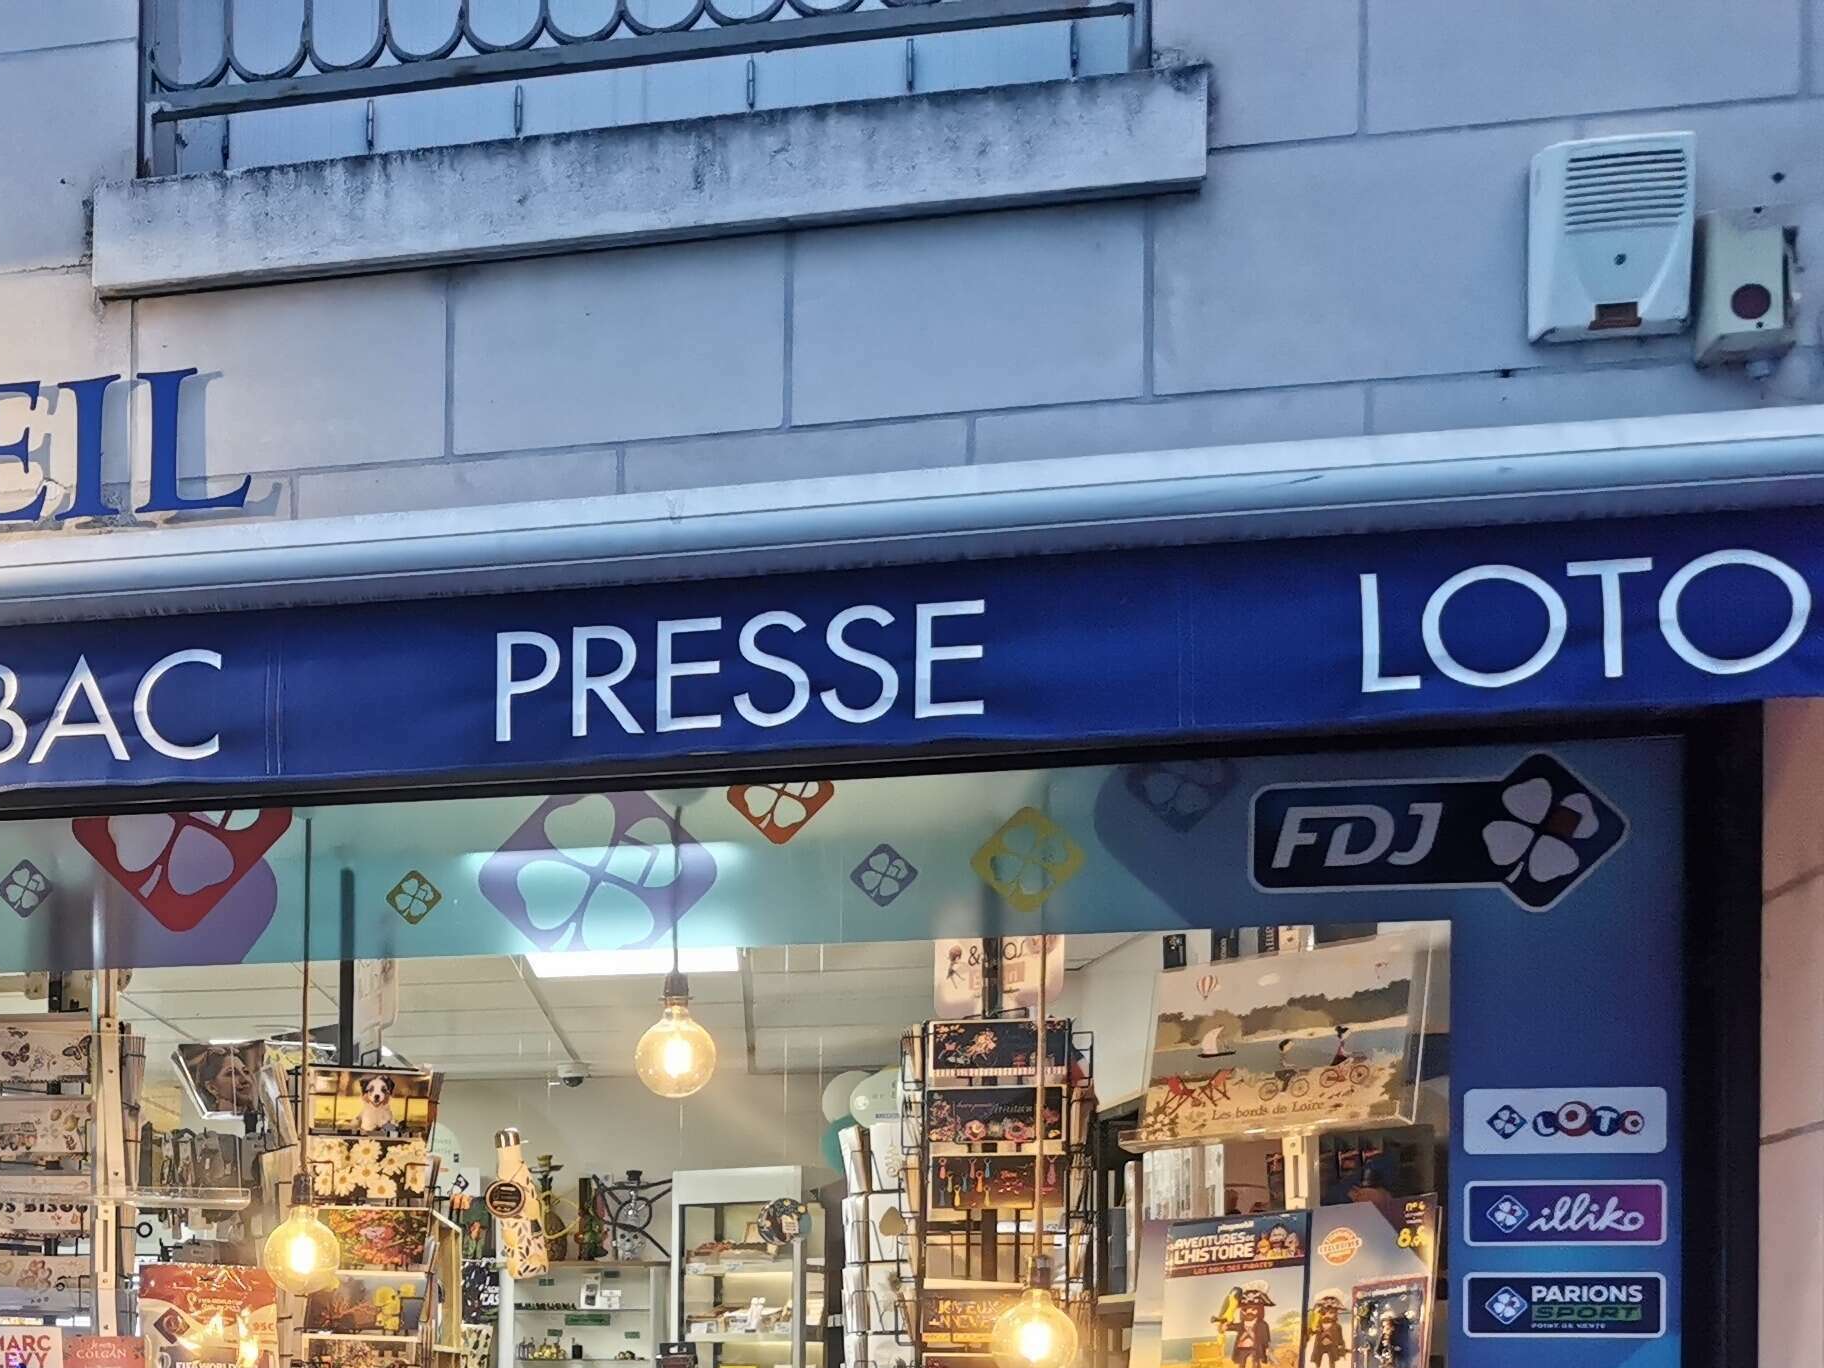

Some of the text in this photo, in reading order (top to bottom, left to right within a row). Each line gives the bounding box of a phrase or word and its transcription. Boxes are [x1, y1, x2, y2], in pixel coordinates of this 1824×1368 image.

[1360, 550, 1813, 692] LOTO
[496, 600, 984, 741] PRESSE
[1272, 802, 1442, 868] FDJ
[1532, 1101, 1644, 1136] LOTO
[1527, 1193, 1644, 1231] illiko
[1174, 1242, 1256, 1266] L'HISTOIRE
[1175, 1232, 1246, 1250] AVENTURES
[1532, 1285, 1642, 1302] PARIONS
[1533, 1305, 1641, 1320] SPORT
